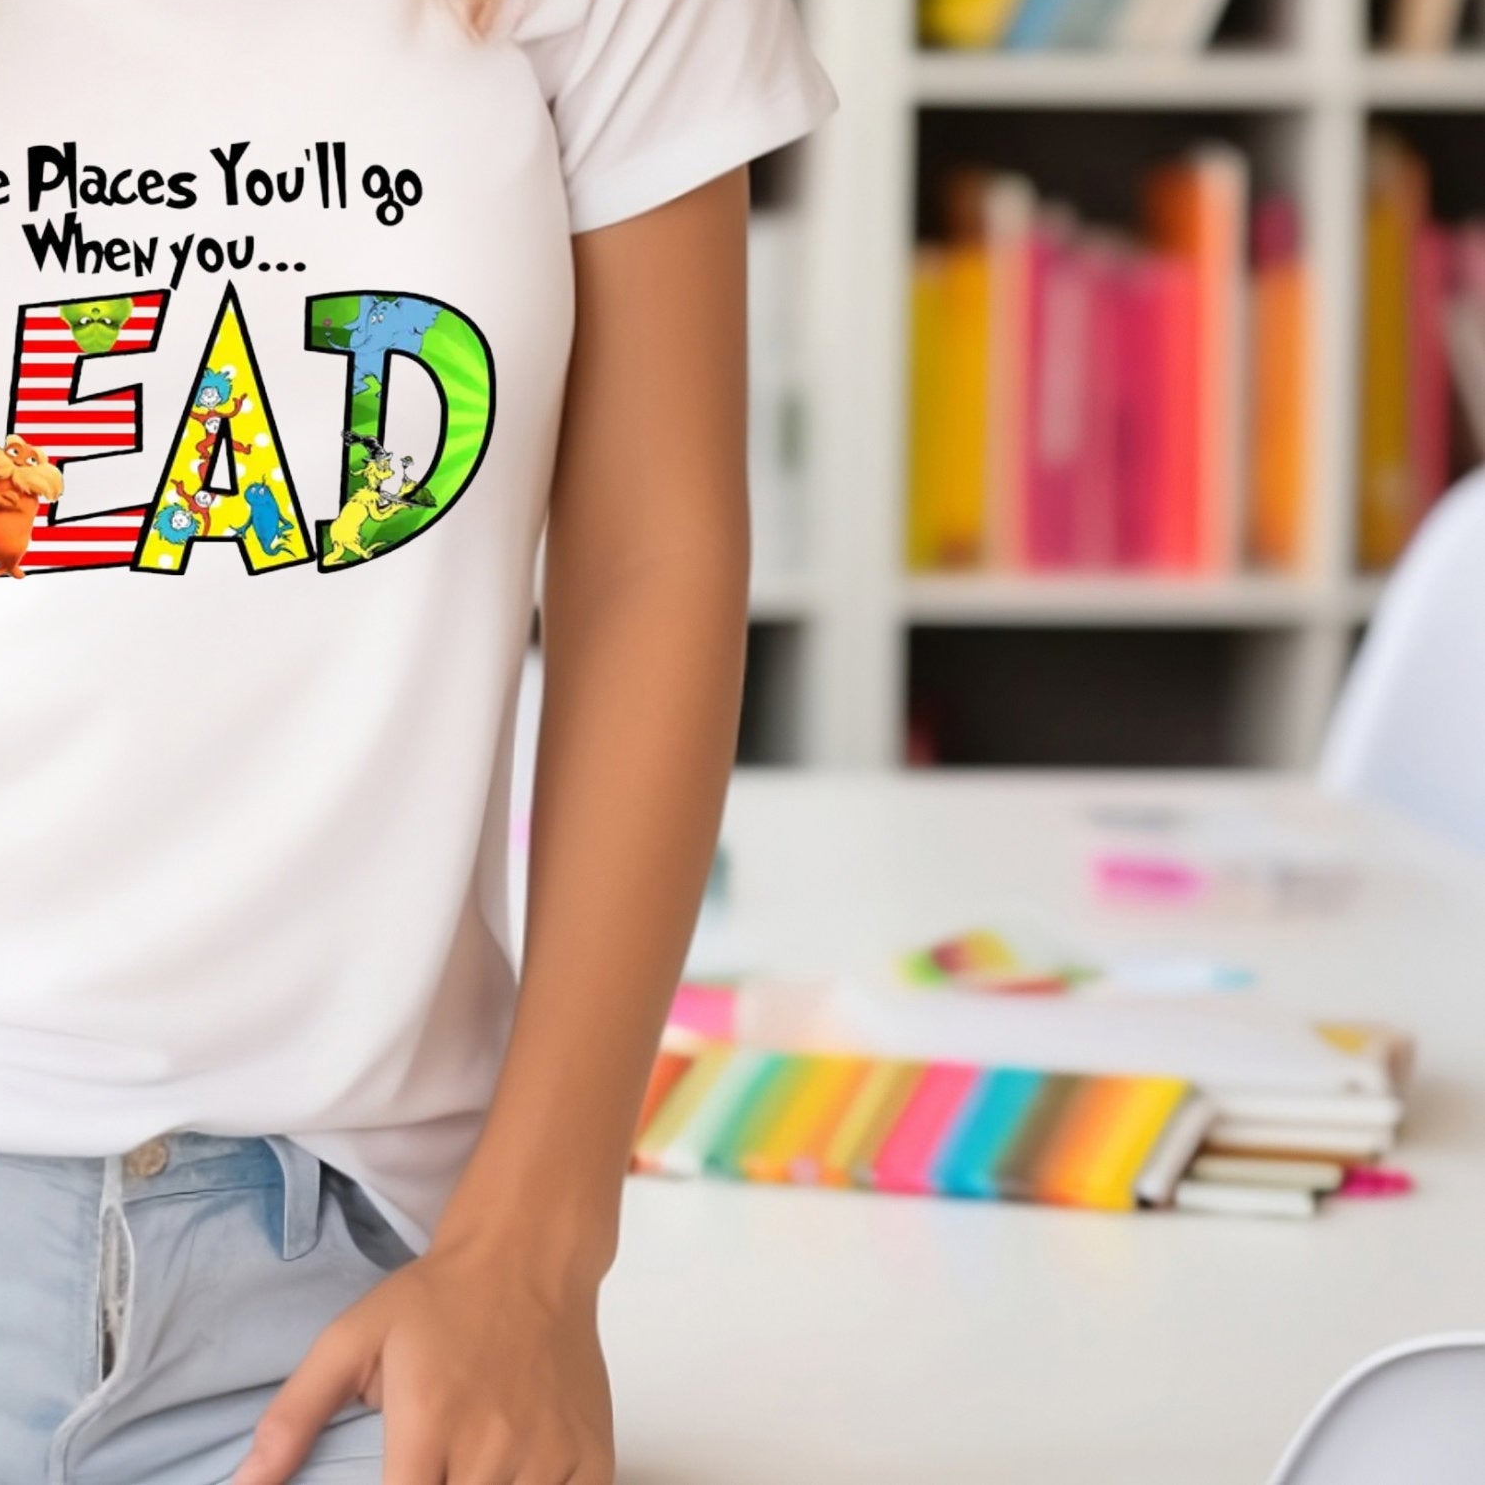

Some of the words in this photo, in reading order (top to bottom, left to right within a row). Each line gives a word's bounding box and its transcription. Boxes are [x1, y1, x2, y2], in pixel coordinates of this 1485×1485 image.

[27, 141, 198, 212] Places
[209, 141, 348, 210] You'll
[361, 163, 424, 226] go
[168, 232, 307, 291] you...
